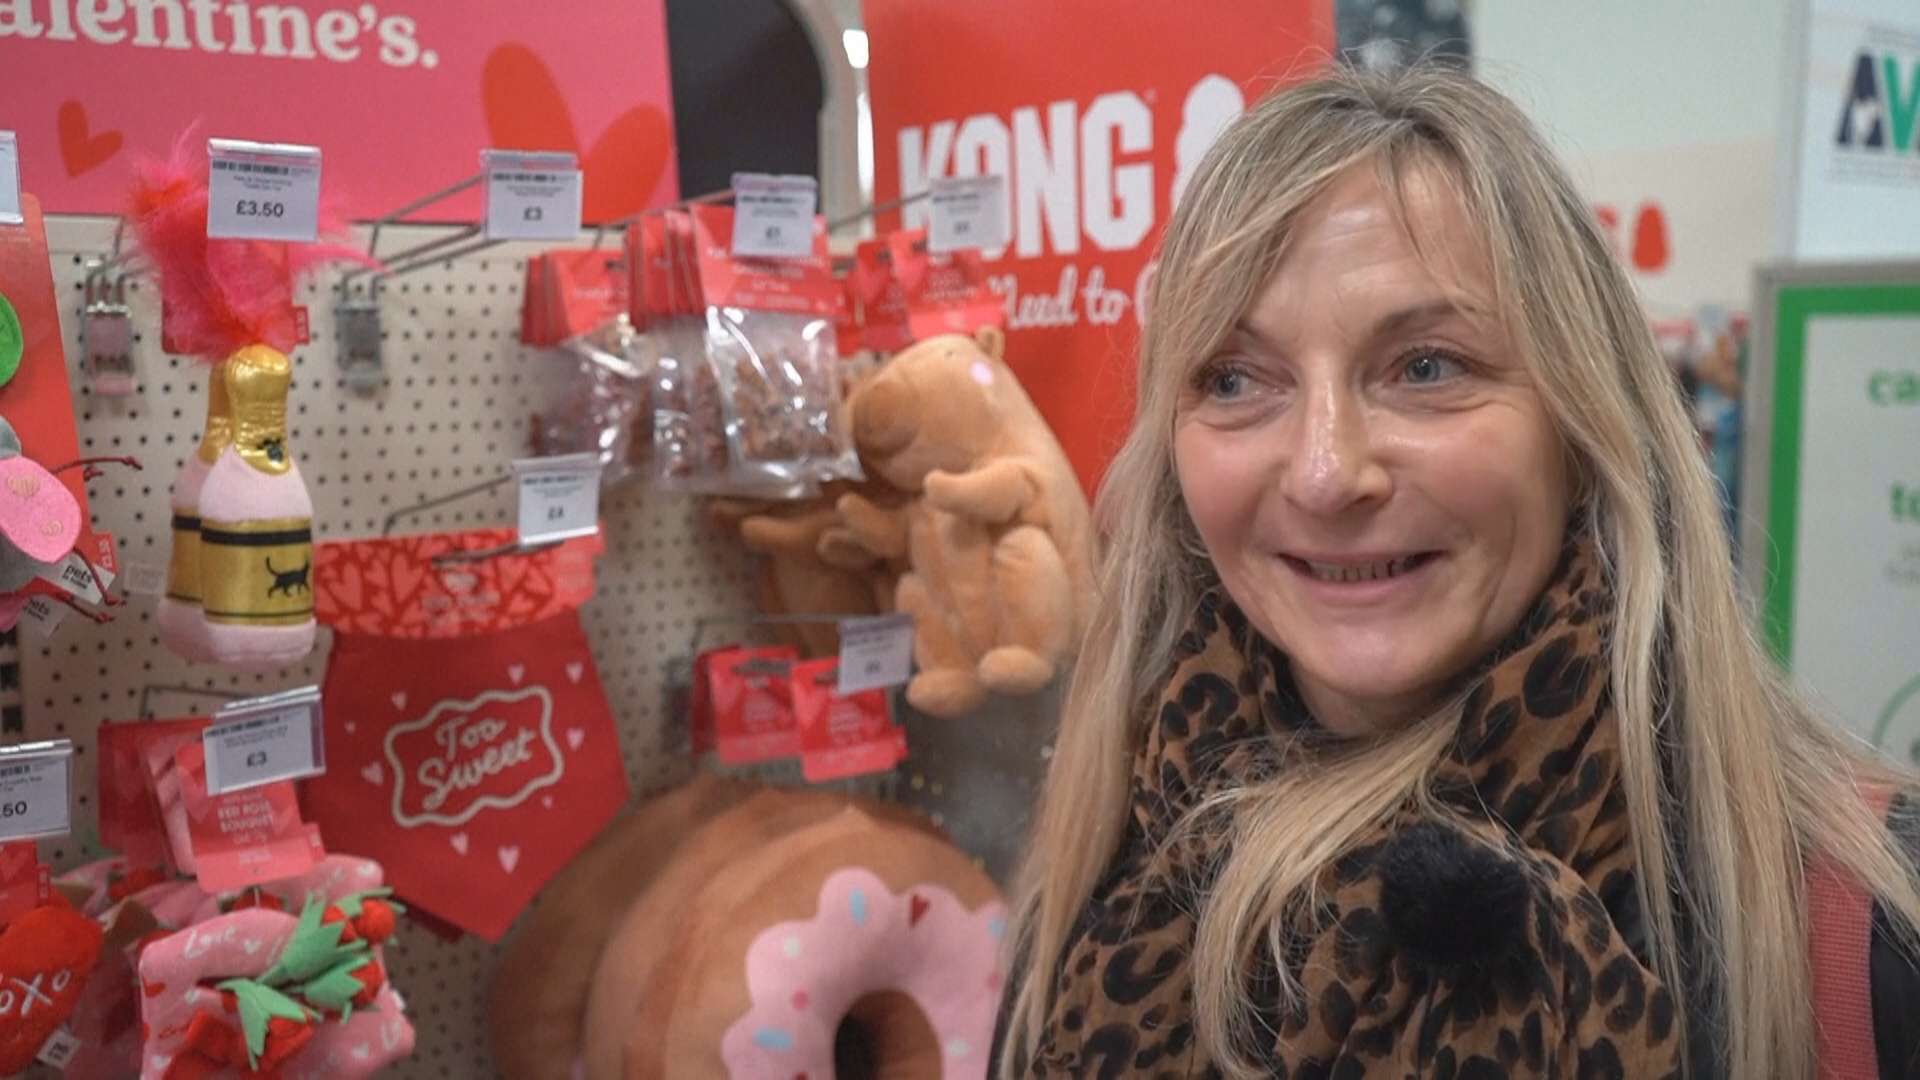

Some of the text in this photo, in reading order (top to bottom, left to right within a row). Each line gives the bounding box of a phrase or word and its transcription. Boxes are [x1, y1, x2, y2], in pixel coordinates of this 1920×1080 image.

[897, 89, 1156, 262] KONG
[236, 199, 284, 218] £3.50
[1080, 265, 1131, 326] to
[62, 565, 93, 584] pets
[246, 750, 268, 768] £3
[434, 715, 507, 761] Too
[417, 727, 537, 811] Sweet
